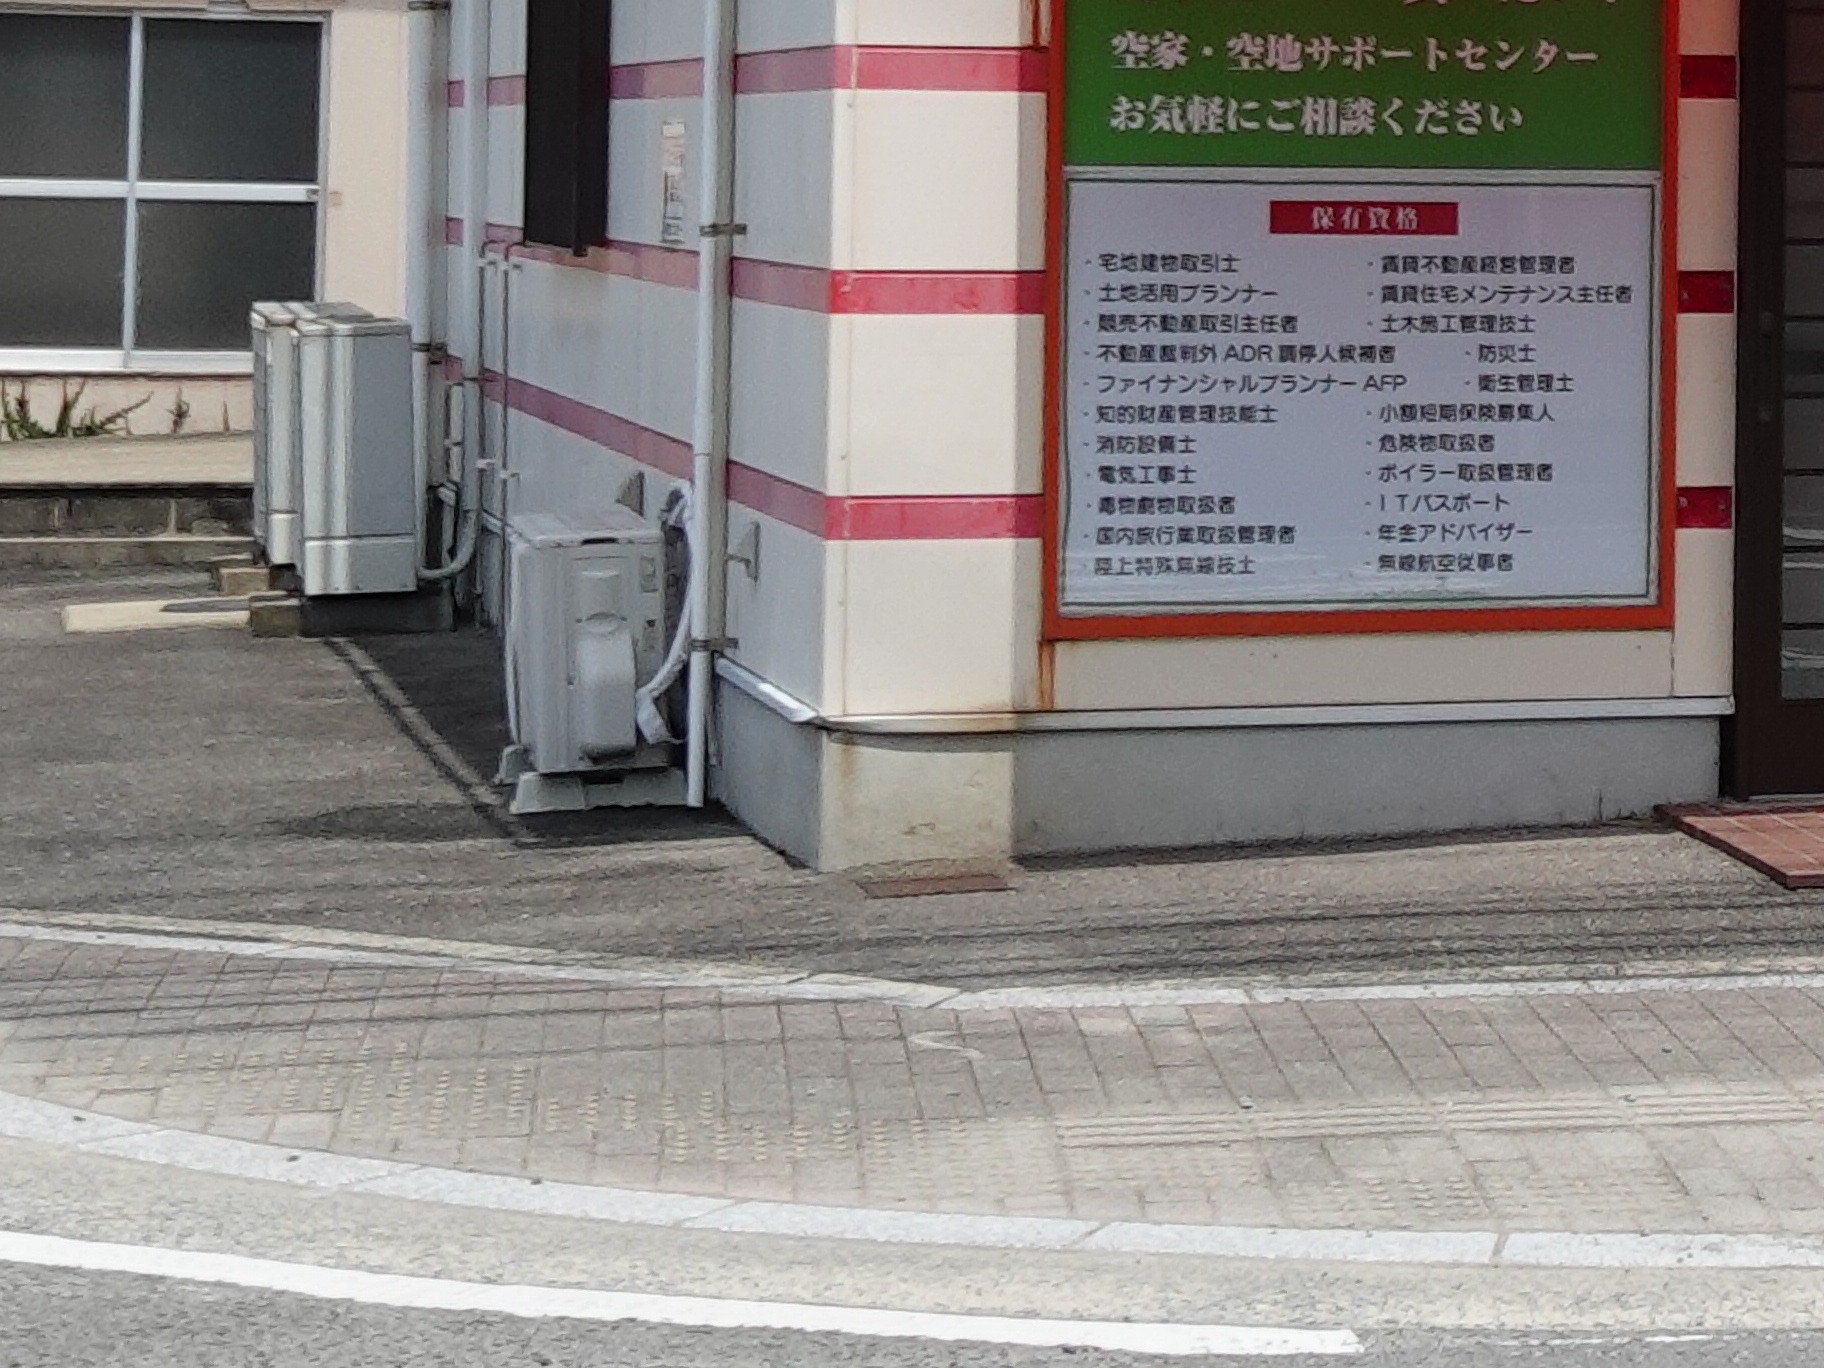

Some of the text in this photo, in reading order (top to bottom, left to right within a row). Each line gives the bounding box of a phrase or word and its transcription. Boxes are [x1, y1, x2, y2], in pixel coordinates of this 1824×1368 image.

[1110, 30, 1598, 73] 空家・空地サポートセンター
[1109, 94, 1523, 136] お気軽にご相談ください
[1310, 205, 1420, 231] 保有資格
